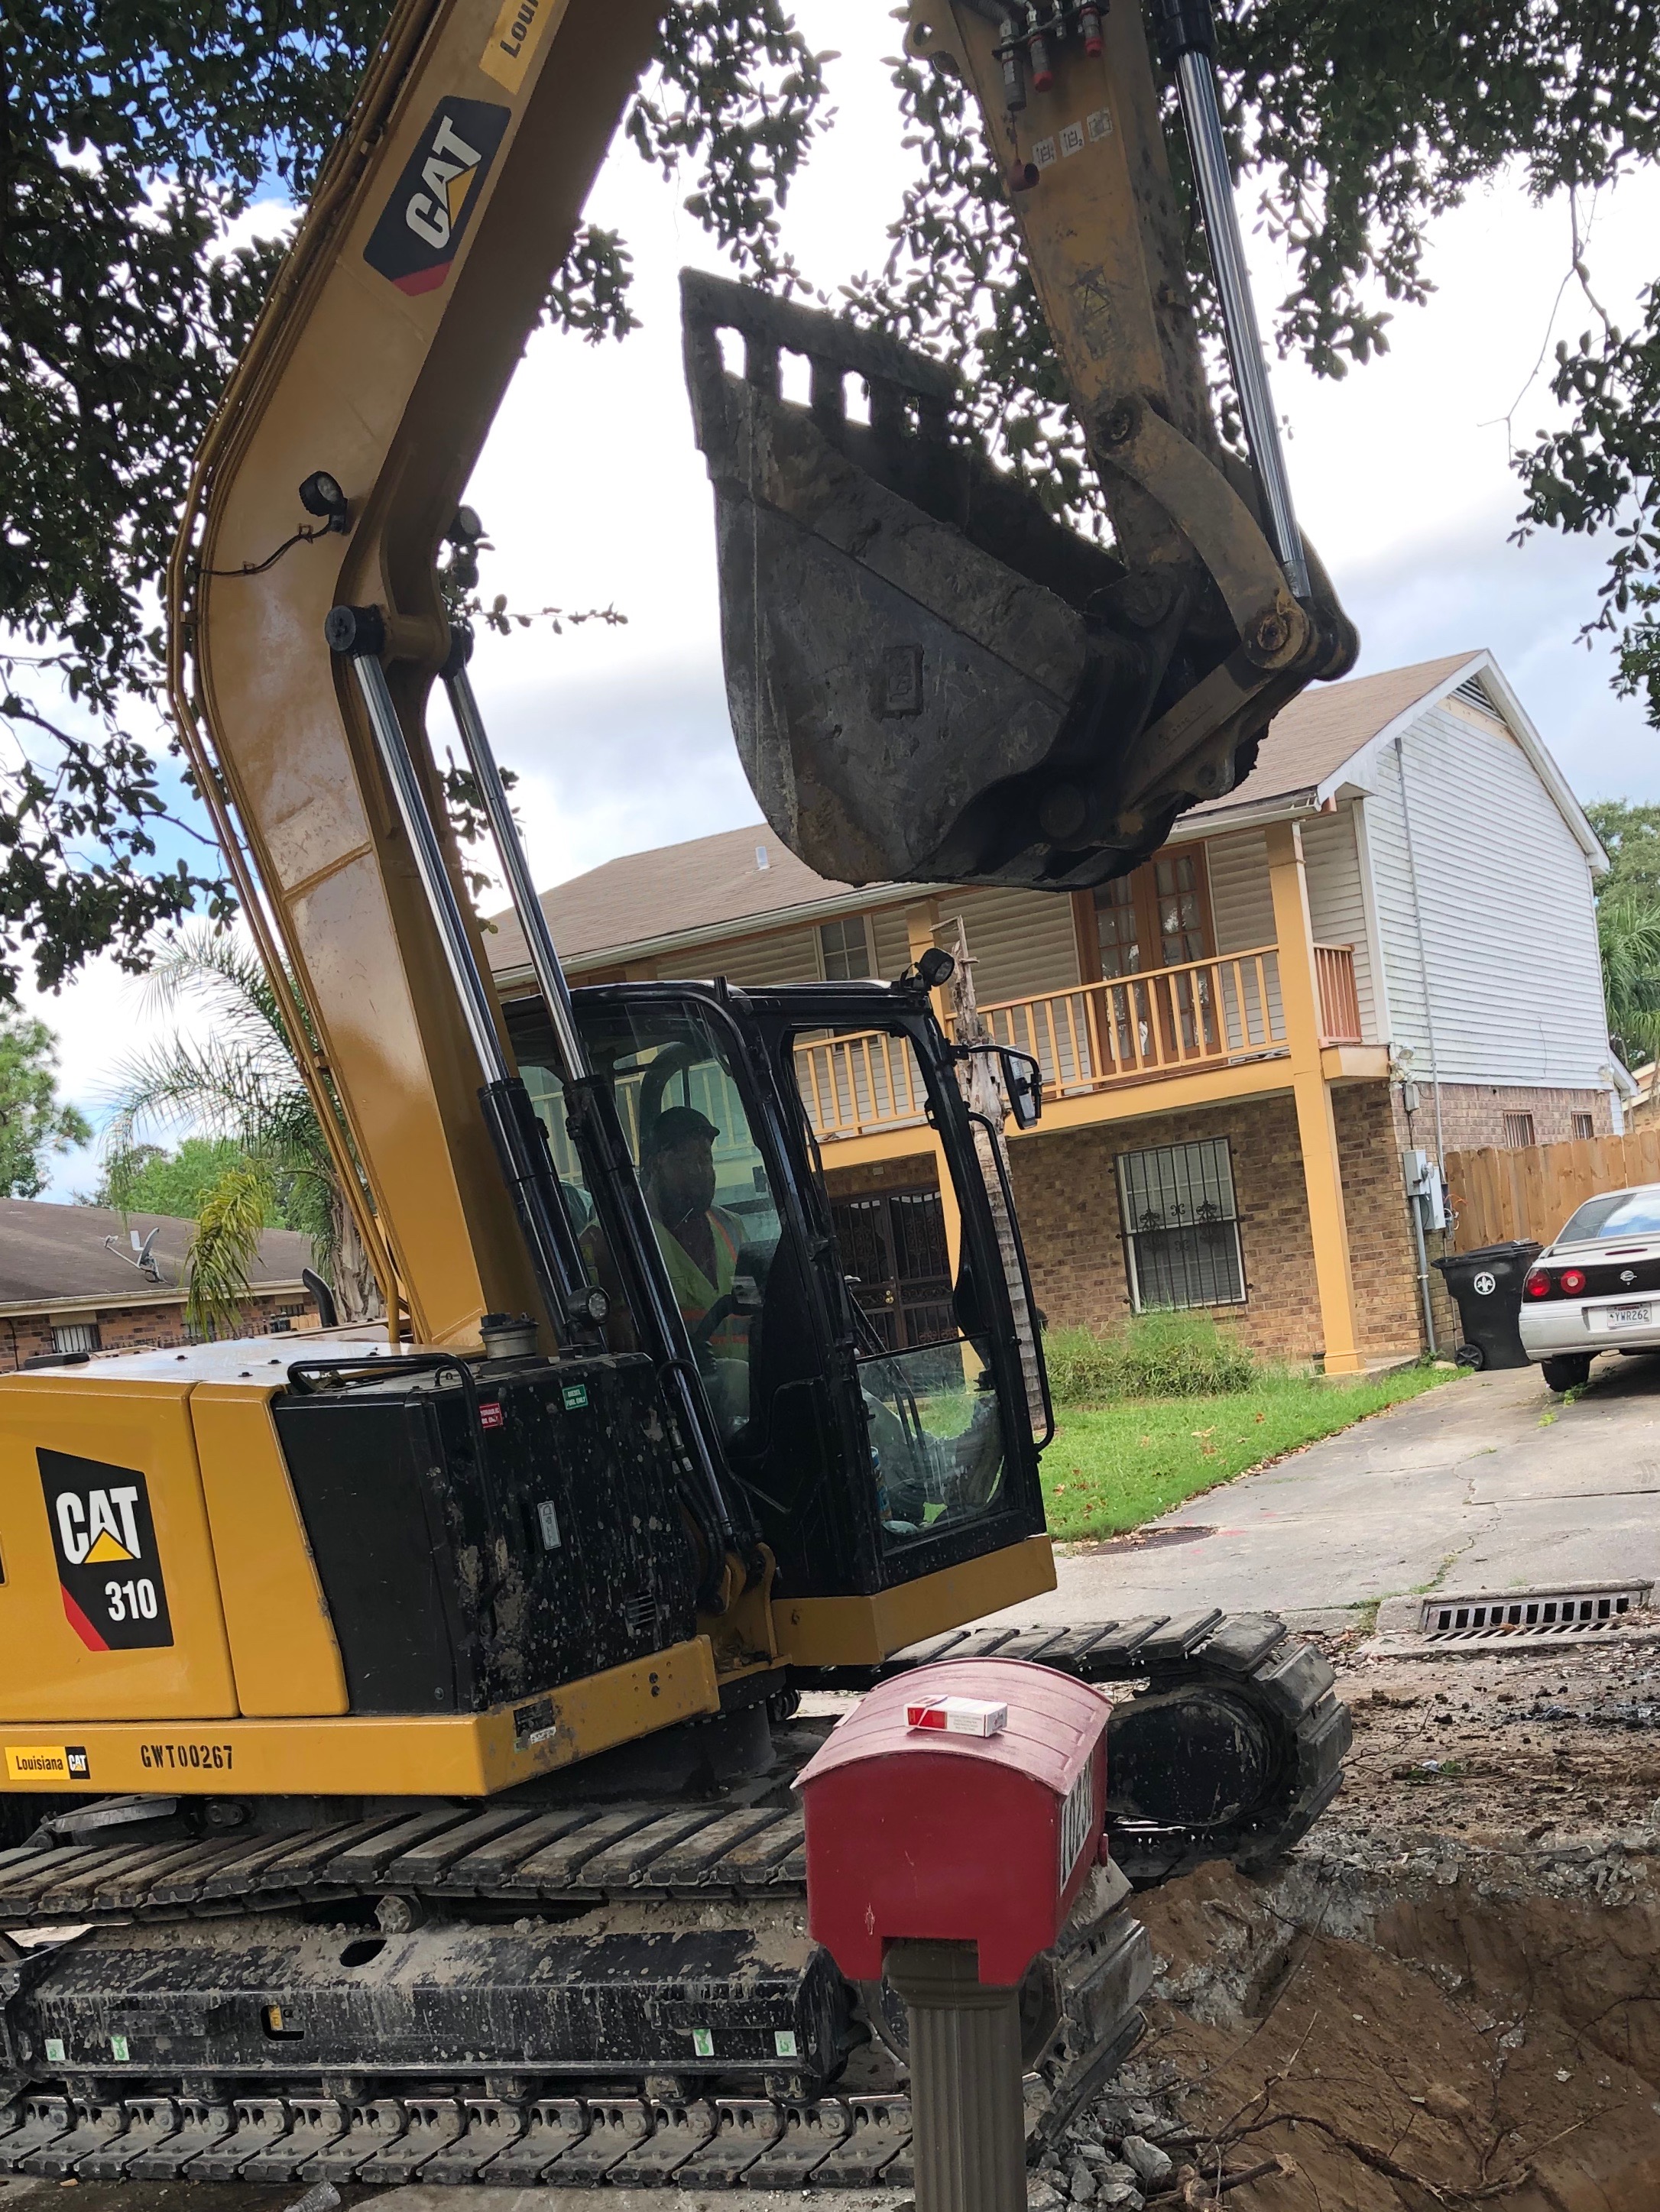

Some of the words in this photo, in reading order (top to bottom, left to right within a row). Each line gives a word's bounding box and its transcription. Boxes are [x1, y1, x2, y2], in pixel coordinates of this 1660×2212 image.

[406, 115, 482, 249] CAT
[56, 1485, 142, 1565] CAT
[105, 1579, 158, 1621] 310
[15, 1755, 64, 1771] Louisiana
[67, 1754, 87, 1771] CAT
[141, 1744, 233, 1770] GWT00267
